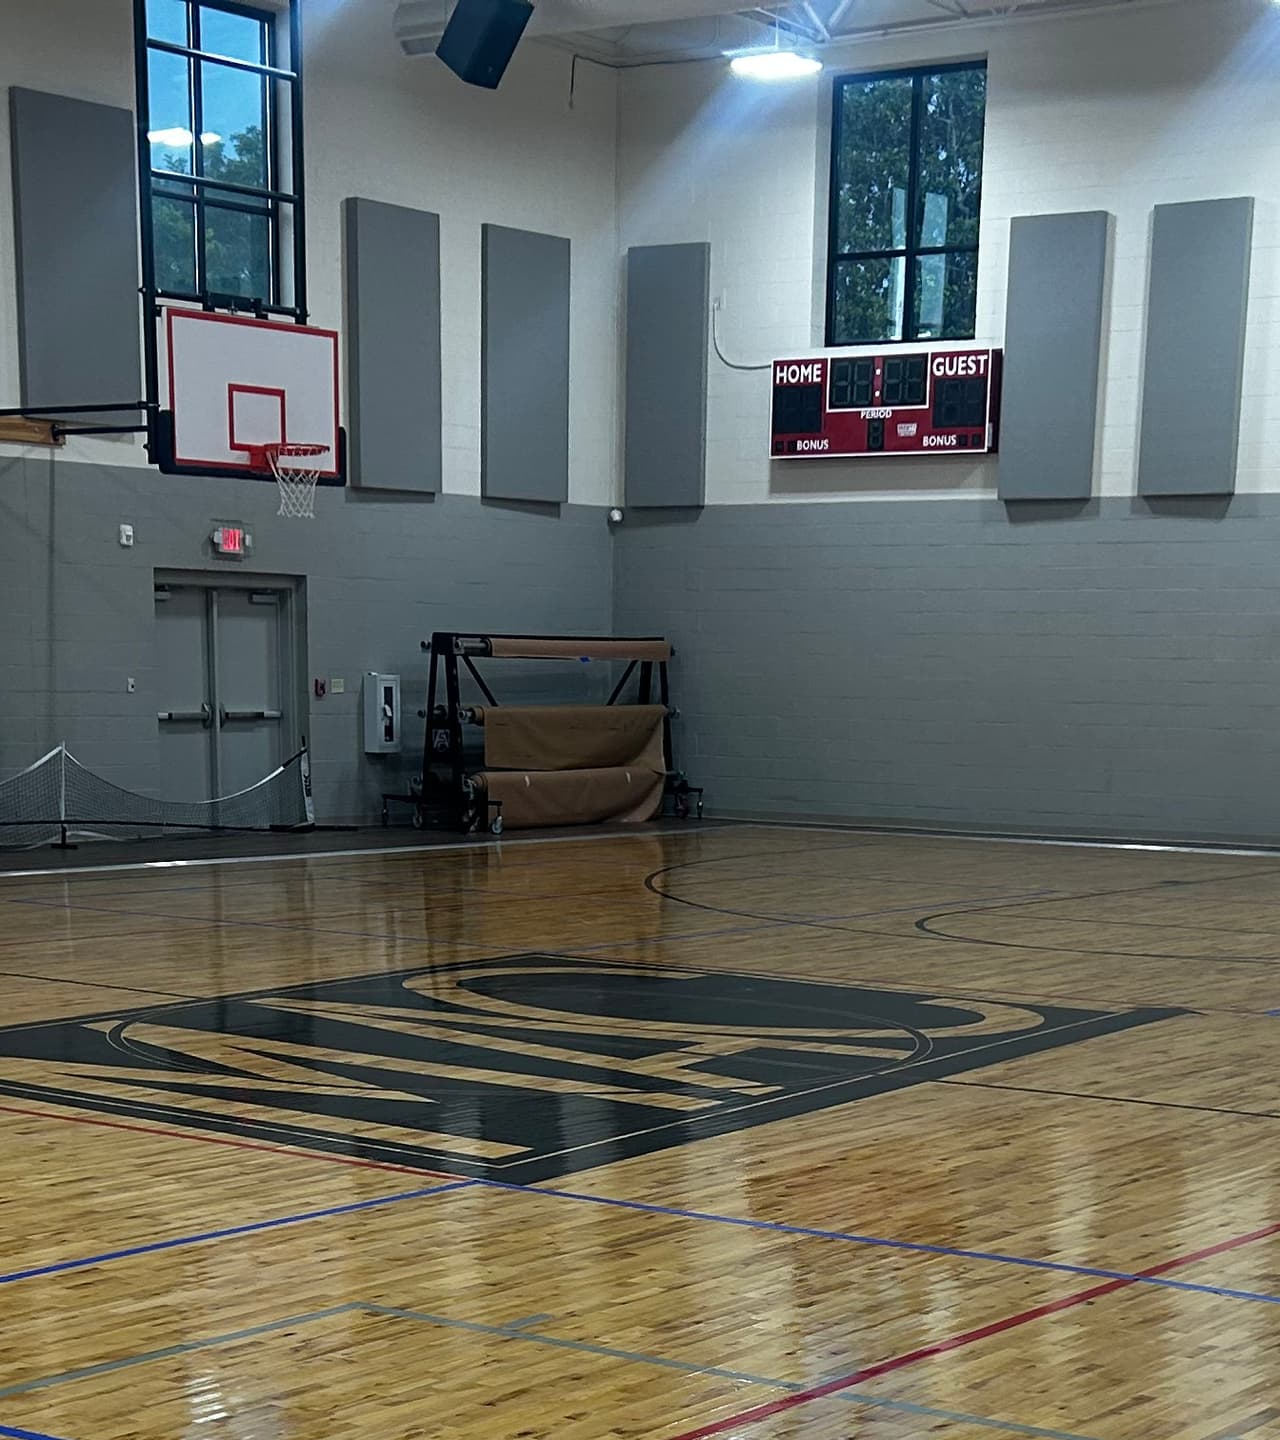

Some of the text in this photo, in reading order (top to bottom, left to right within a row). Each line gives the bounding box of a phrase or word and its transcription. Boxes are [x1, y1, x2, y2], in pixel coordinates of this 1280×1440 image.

[932, 354, 989, 377] GUEST
[775, 363, 822, 384] HOME
[860, 409, 893, 419] PERIOD
[796, 439, 829, 451] BONUS
[922, 434, 957, 447] BONUS
